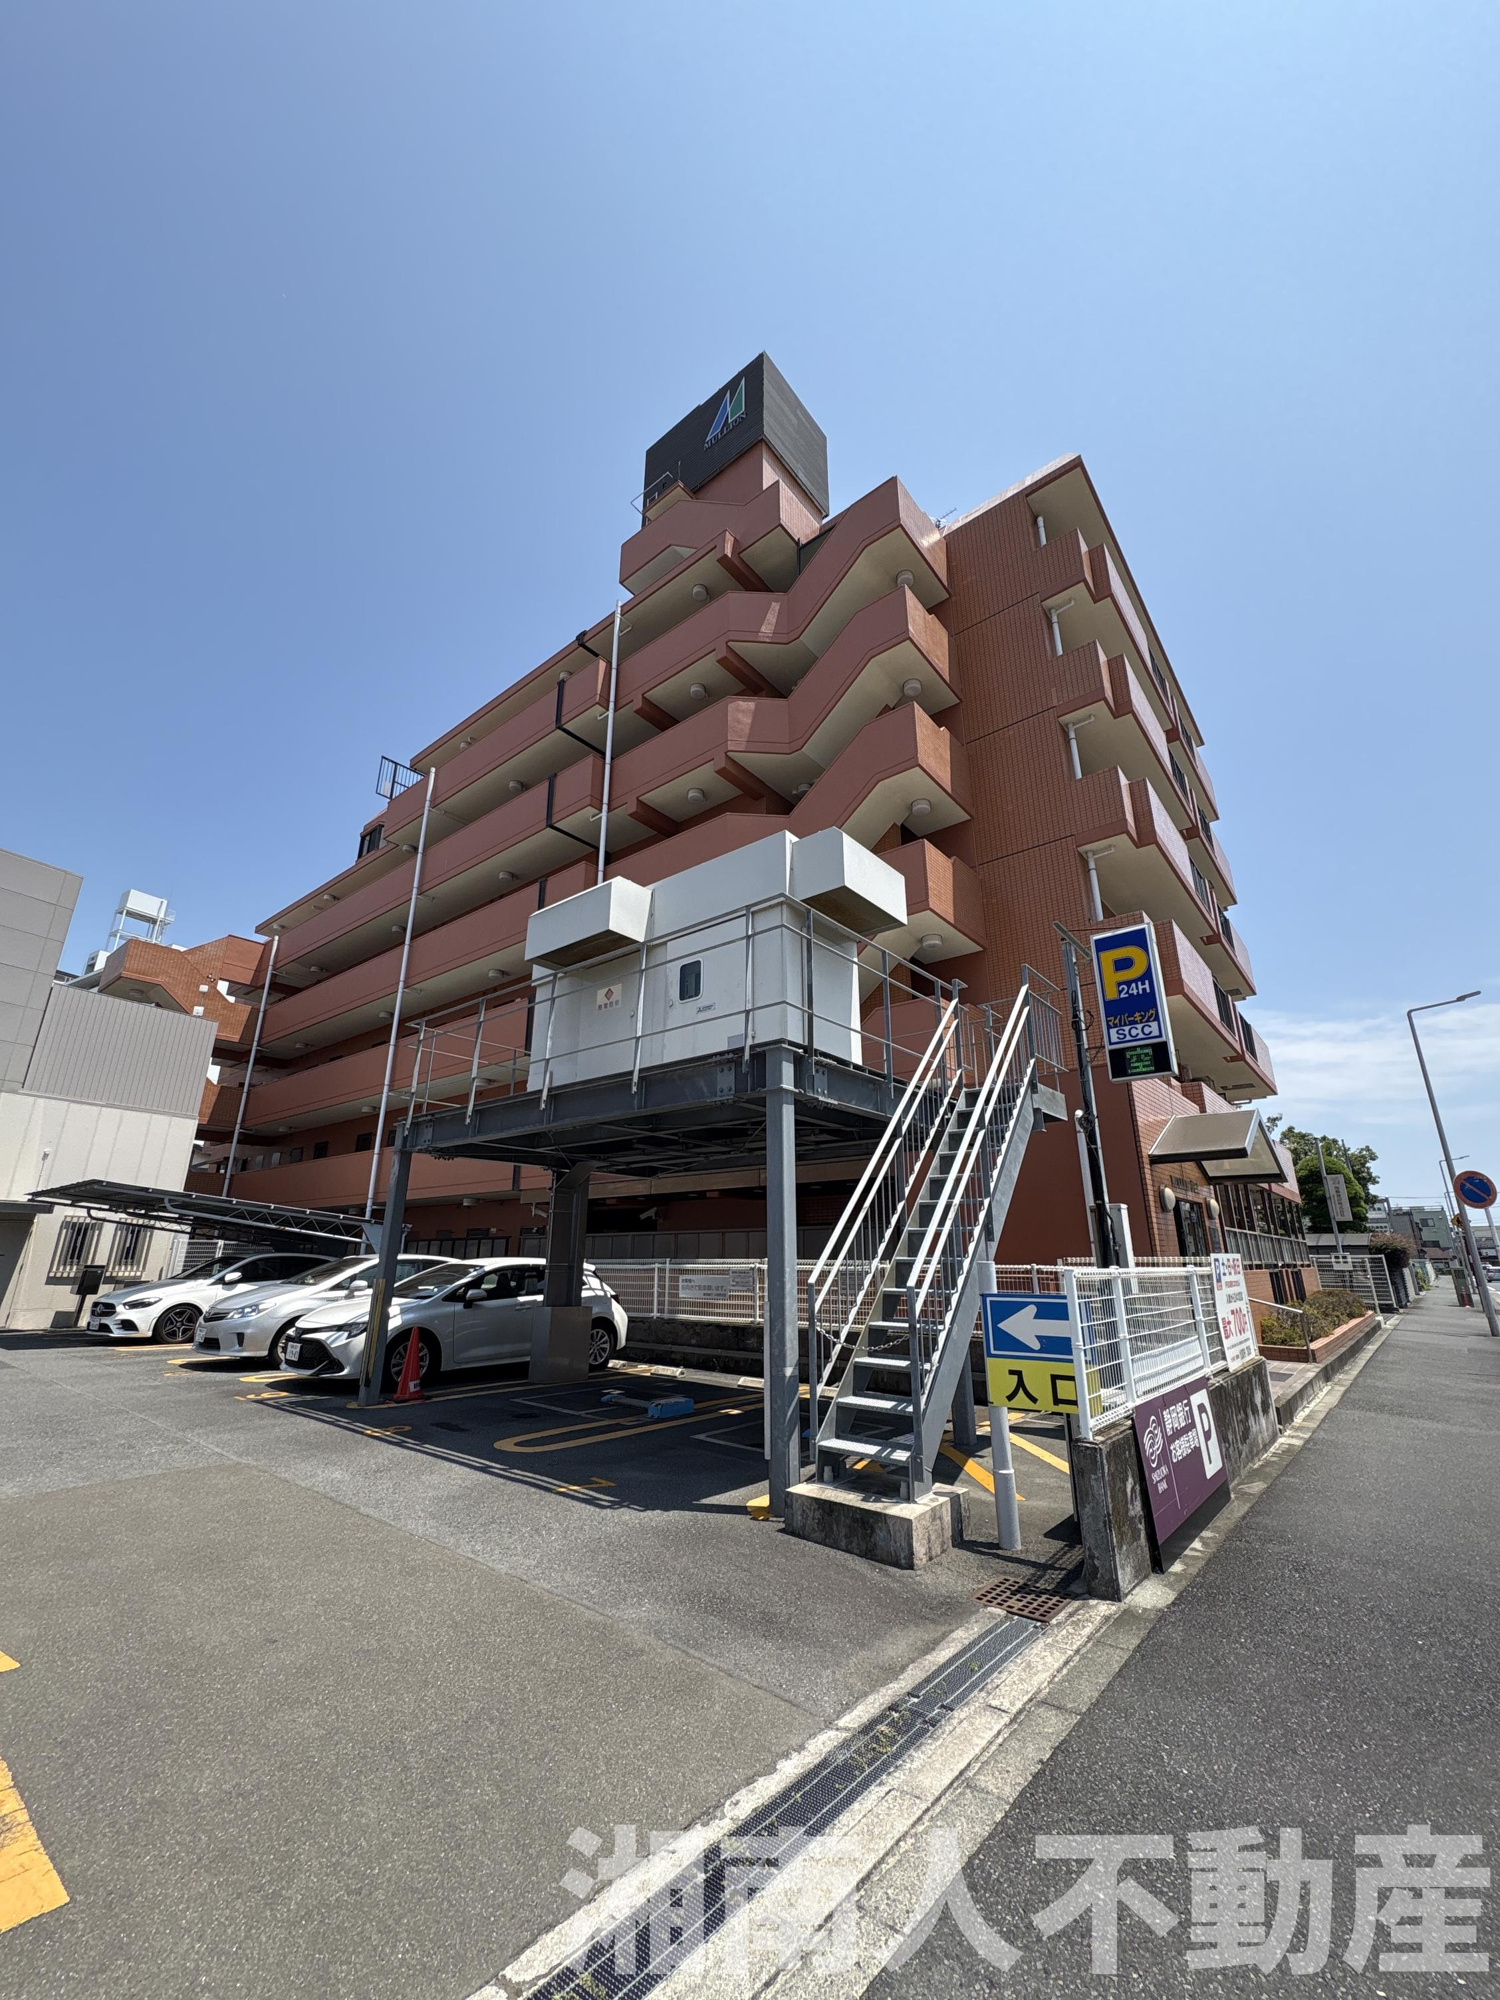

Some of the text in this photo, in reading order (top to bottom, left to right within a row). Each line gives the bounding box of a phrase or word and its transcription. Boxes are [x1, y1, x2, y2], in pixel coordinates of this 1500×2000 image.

[703, 411, 747, 451] MULLION
[1098, 945, 1149, 1001] P
[1119, 979, 1150, 998] 24H
[1107, 1008, 1156, 1028] マイパーキング
[1116, 1024, 1153, 1040] SCC
[1006, 1369, 1078, 1407] 入口
[1162, 1399, 1192, 1437] 静岡銀行
[1196, 1402, 1213, 1465] P
[1157, 1479, 1169, 1494] BANK
